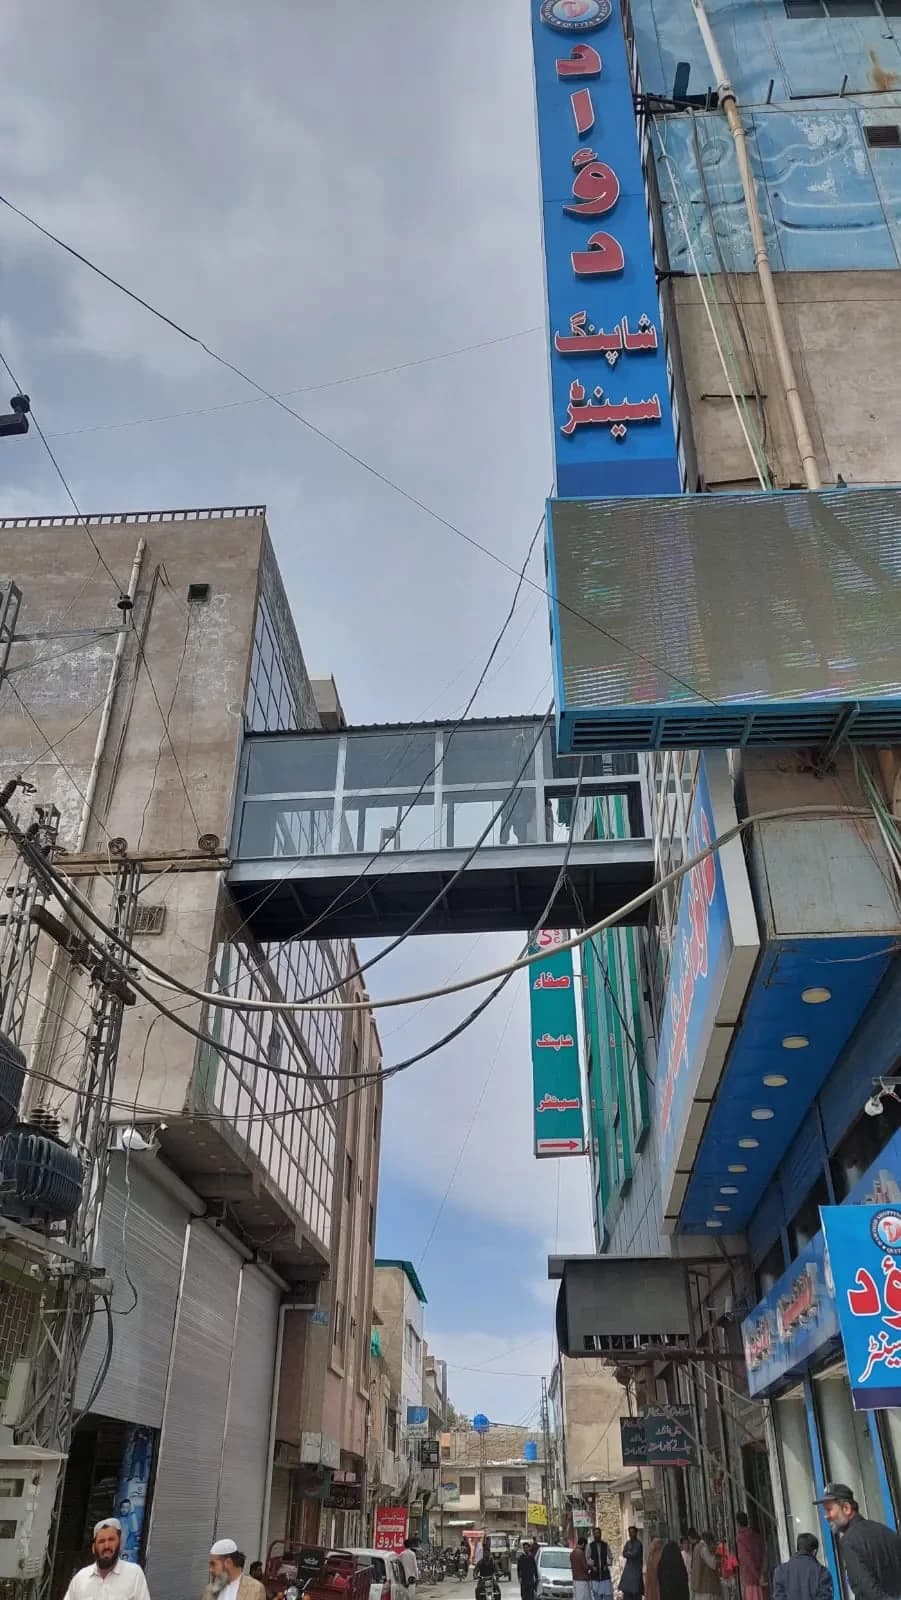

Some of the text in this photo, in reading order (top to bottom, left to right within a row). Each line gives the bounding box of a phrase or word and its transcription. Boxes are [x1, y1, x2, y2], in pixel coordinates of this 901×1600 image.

[554, 310, 659, 366] شاپنگ
[560, 378, 662, 438] سینٹر
[533, 972, 571, 990] صفاء
[377, 1532, 404, 1548] فاروق
